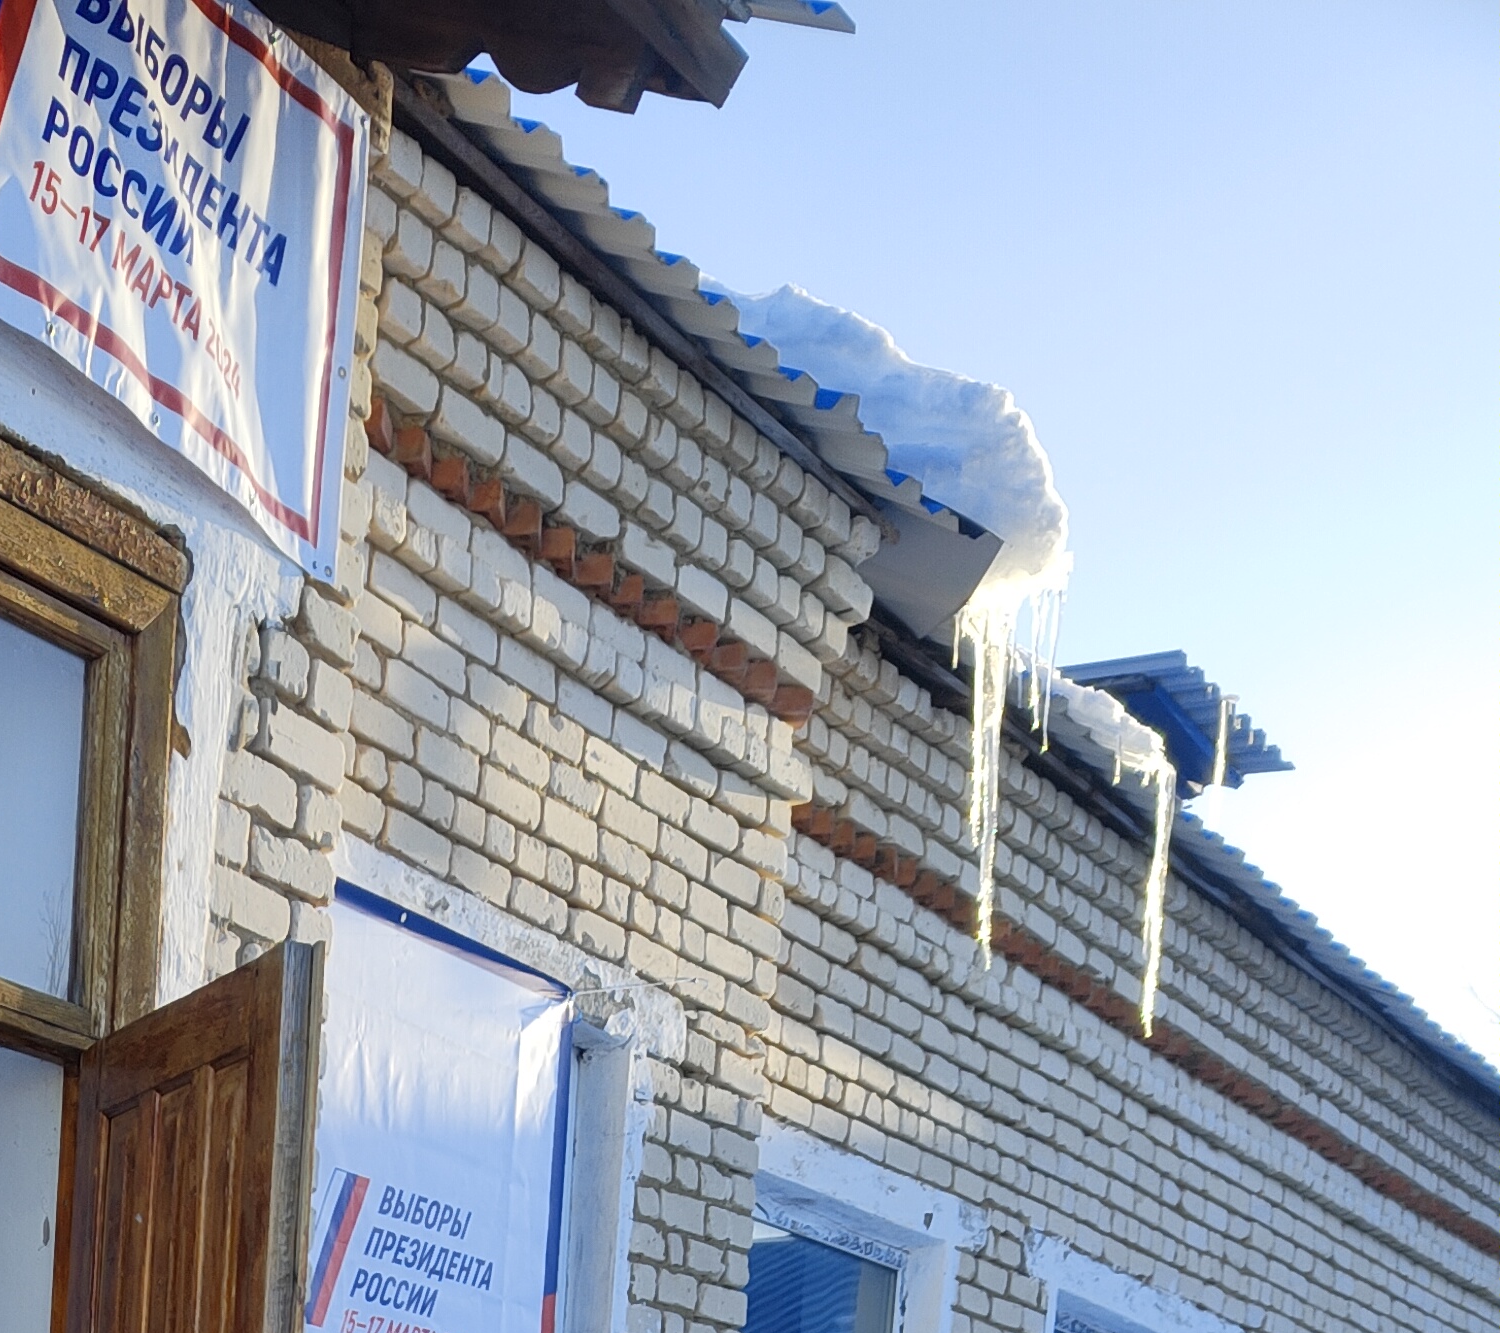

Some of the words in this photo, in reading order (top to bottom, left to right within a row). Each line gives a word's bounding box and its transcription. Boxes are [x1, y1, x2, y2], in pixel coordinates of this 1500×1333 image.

[41, 95, 194, 266] РОССИИ
[58, 34, 287, 287] ПРЕЗИДЕНТА
[111, 229, 202, 341] МАРТА
[378, 1185, 473, 1240] ВЫБОРЫ
[349, 1268, 439, 1318] РОССИИ
[364, 1226, 494, 1291] ПРЕЗИДЕНТА
